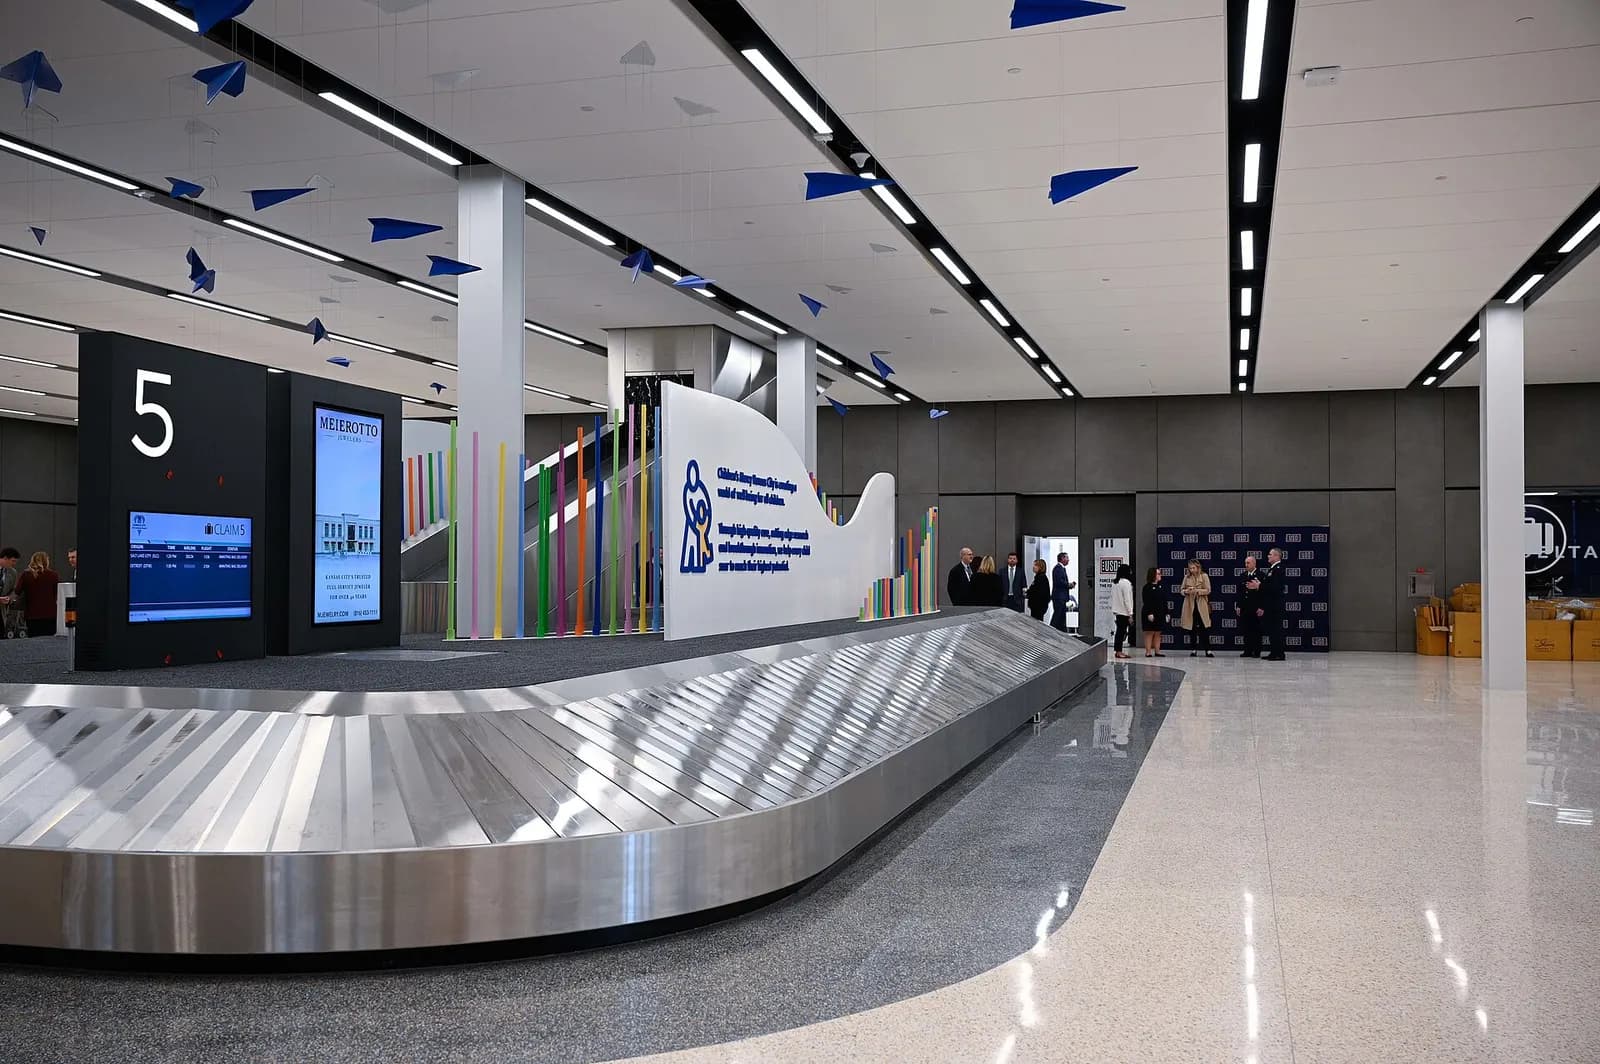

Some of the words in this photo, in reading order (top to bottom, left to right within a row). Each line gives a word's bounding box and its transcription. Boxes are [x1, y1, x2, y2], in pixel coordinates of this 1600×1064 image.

[131, 368, 174, 458] 5
[320, 416, 378, 437] MEIEROTTO
[214, 523, 240, 536] CLAIM
[240, 524, 245, 536] 5
[1525, 546, 1598, 558] ELTA
